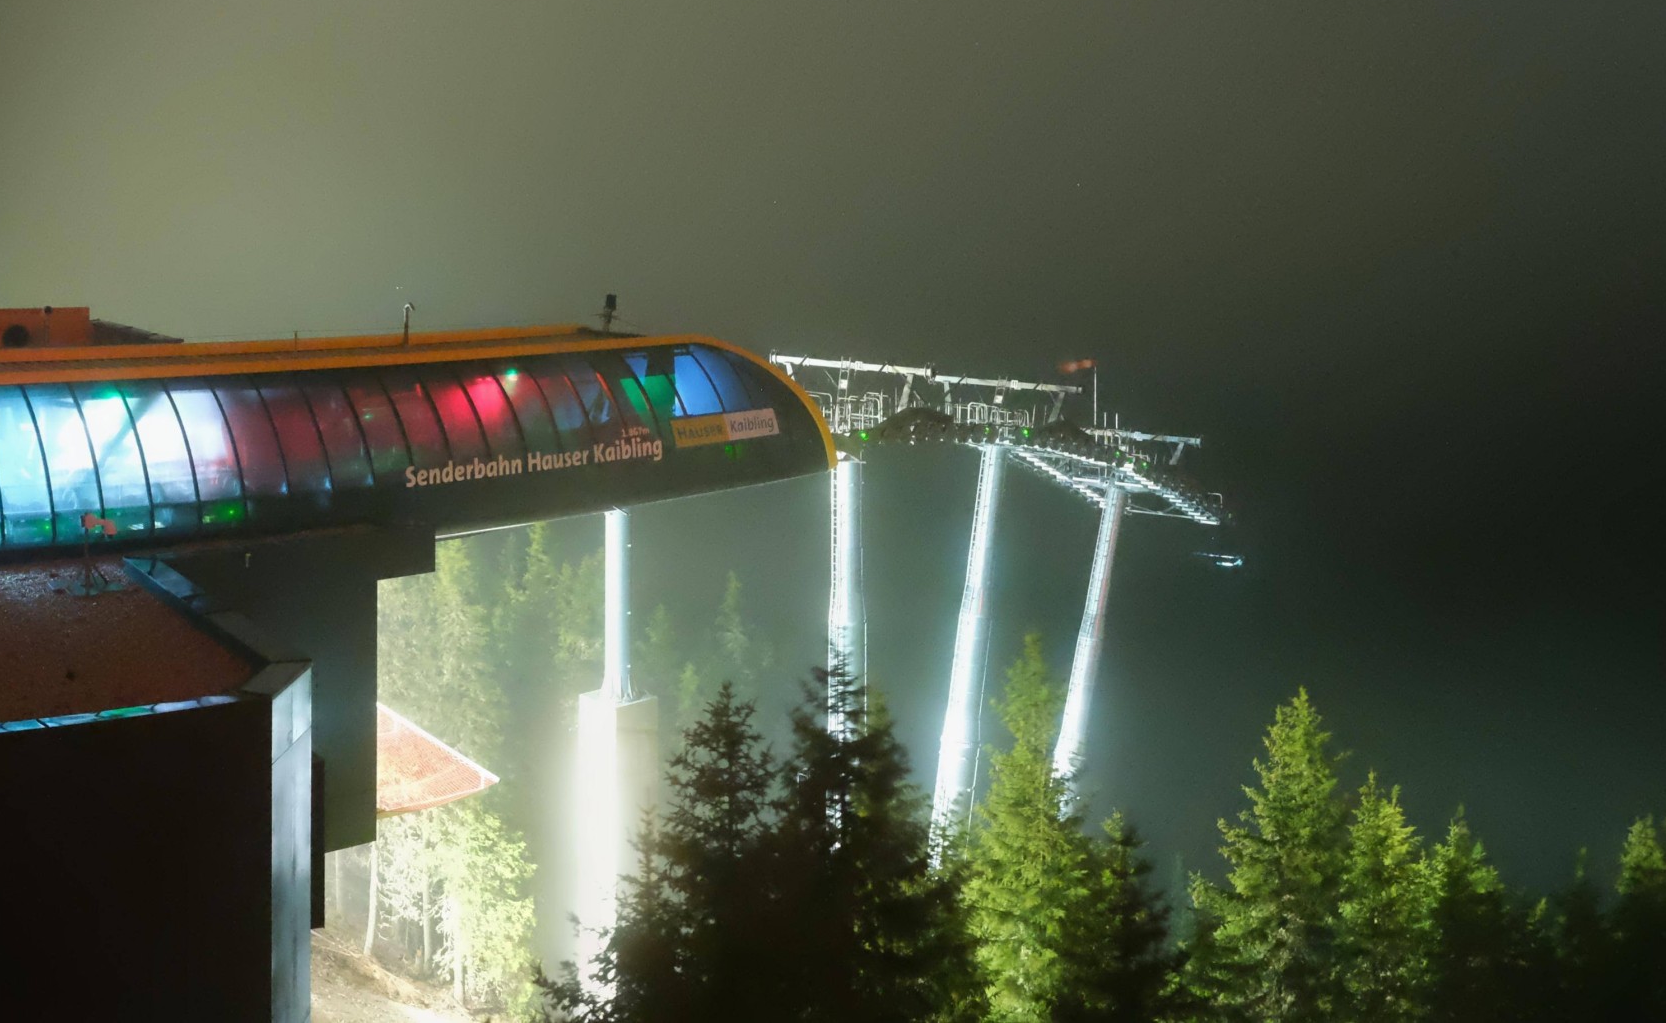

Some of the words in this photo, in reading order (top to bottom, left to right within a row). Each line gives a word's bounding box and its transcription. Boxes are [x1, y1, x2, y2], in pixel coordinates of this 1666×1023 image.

[678, 423, 723, 440] HAUSER
[730, 416, 774, 433] Kaibling
[405, 454, 523, 488] Senderbahn
[527, 449, 589, 473] Hauser
[593, 438, 663, 463] Kaibling
